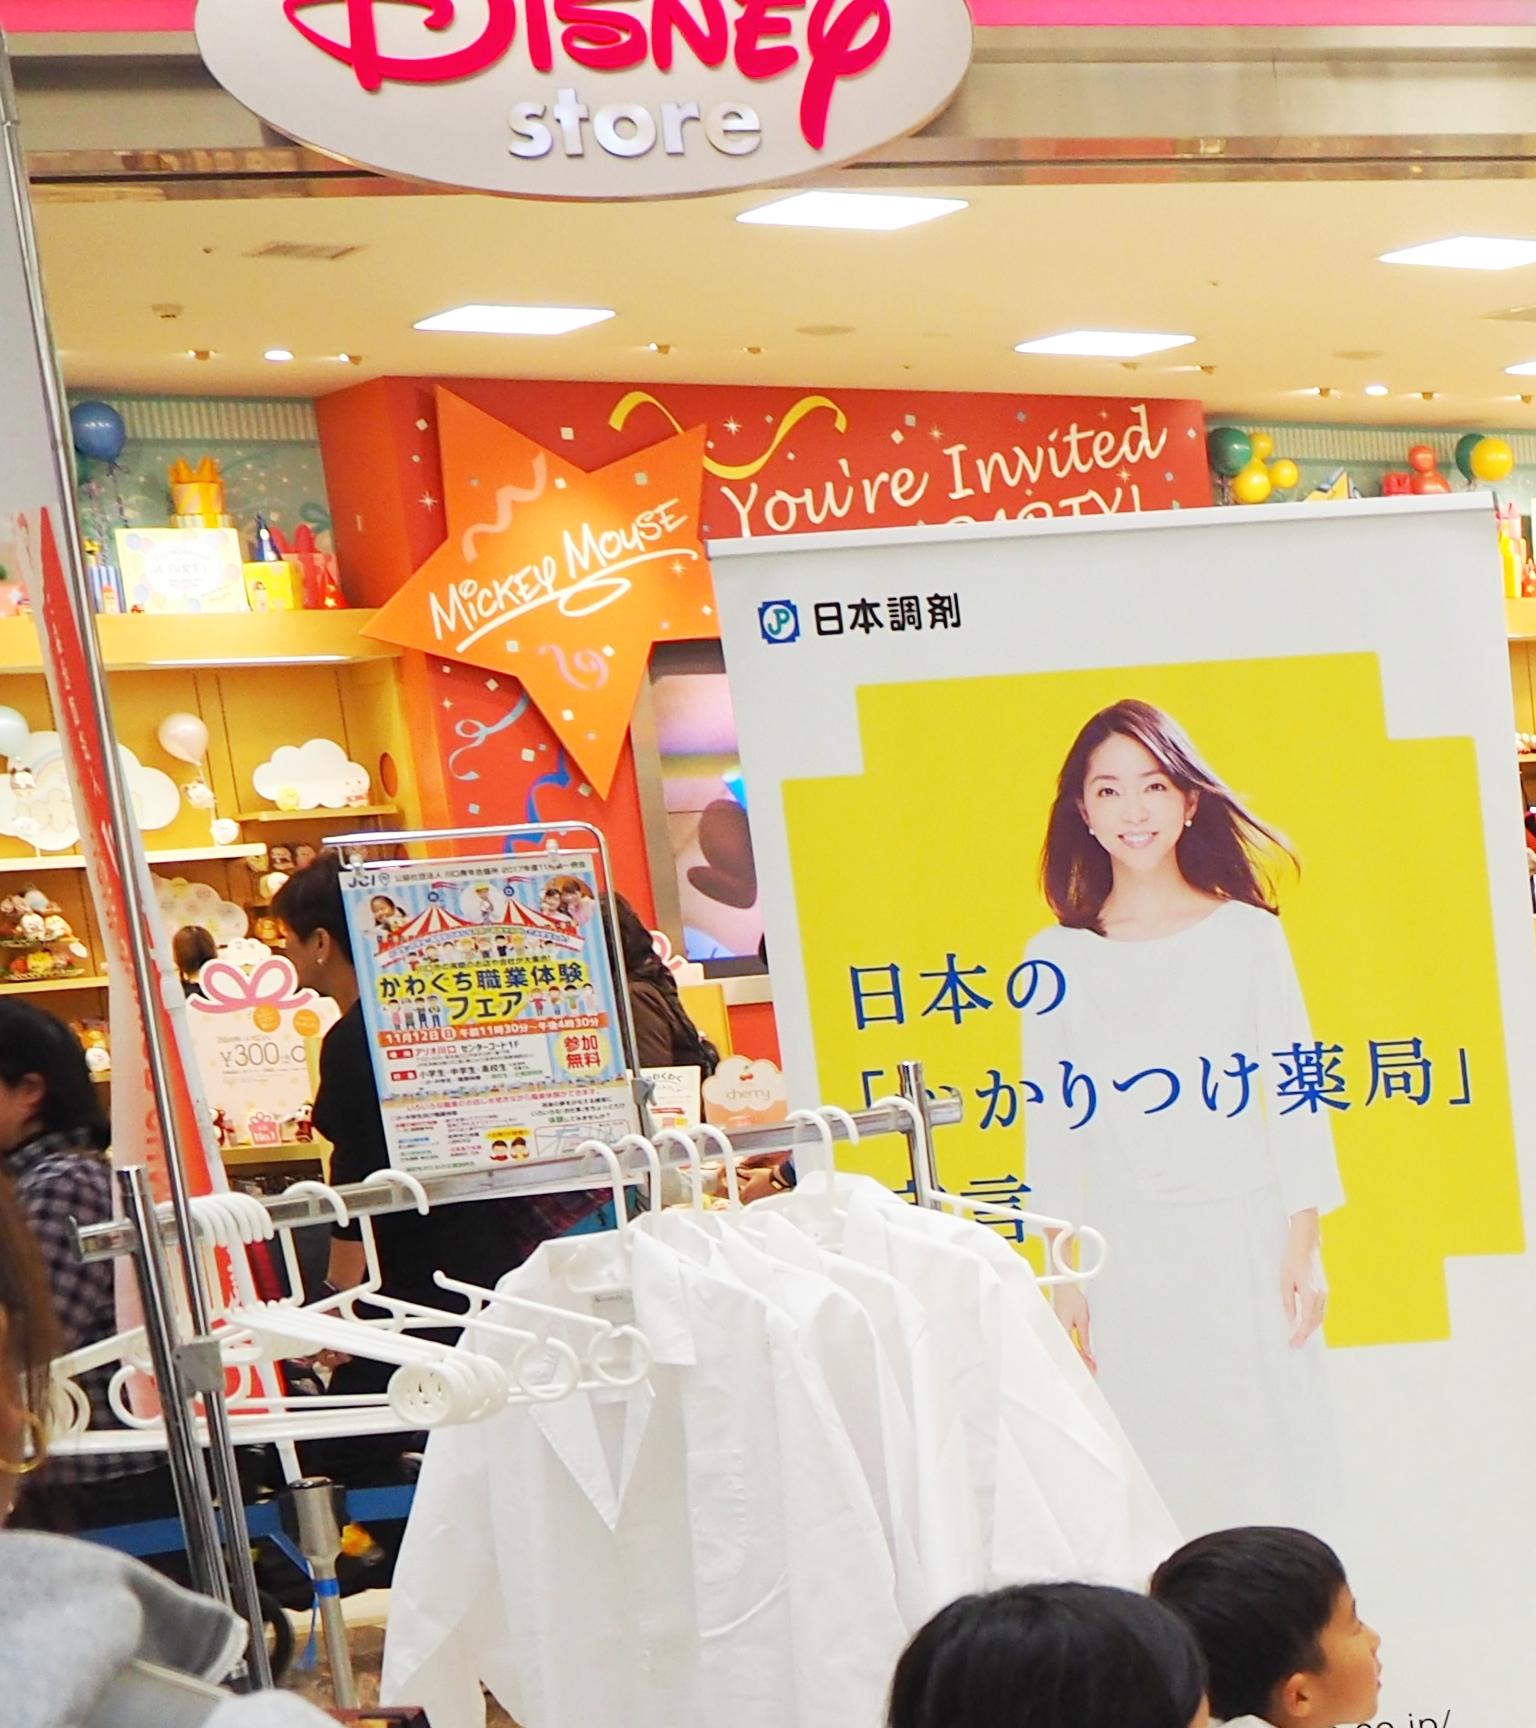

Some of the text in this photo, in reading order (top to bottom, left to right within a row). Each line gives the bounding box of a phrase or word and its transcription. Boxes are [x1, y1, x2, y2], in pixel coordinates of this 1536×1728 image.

[509, 88, 762, 159] store
[720, 403, 1168, 537] You're Invited
[813, 592, 961, 637] 日本調剤
[348, 873, 376, 889] JCI
[447, 991, 523, 1020] フェア
[848, 952, 1068, 1032] 日本の
[563, 1034, 599, 1051] 参加
[565, 1050, 601, 1068] 無料
[725, 1088, 770, 1100] cherry
[861, 1036, 1473, 1132] 「かりつけ薬局」
